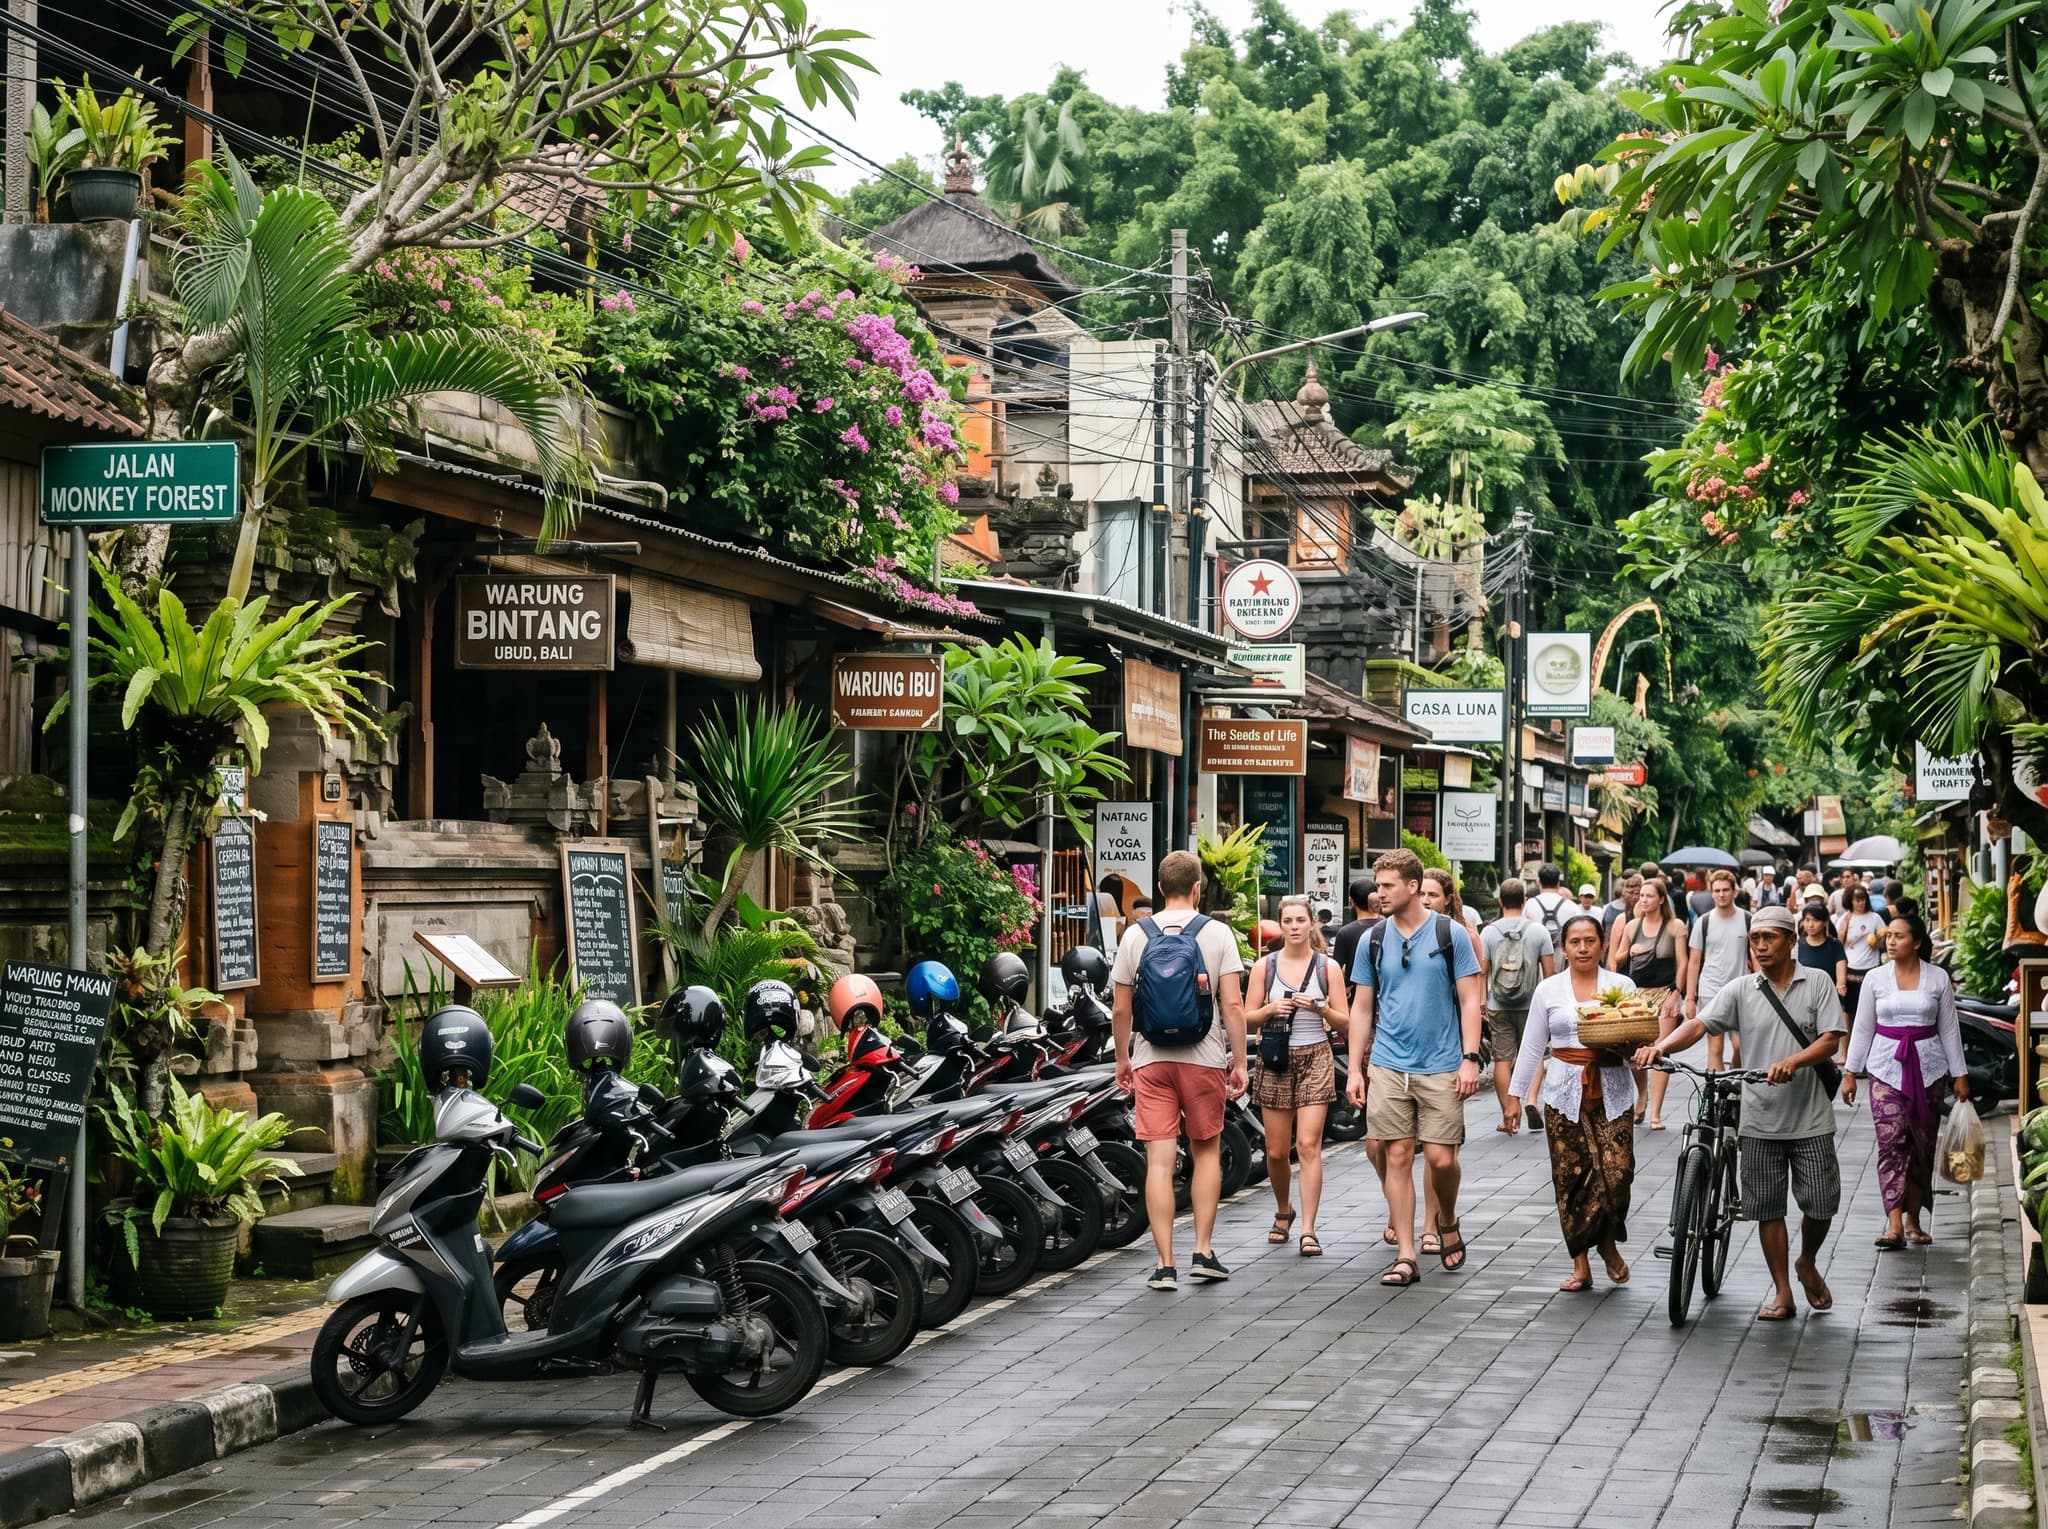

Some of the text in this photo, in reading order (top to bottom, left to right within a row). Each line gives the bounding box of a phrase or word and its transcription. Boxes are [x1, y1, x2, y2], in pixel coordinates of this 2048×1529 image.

[103, 453, 175, 479] JALAN
[51, 485, 228, 513] MONKEY FOREST
[485, 584, 584, 605] WARUNG
[467, 610, 602, 640] BINTANG
[494, 646, 573, 662] UBUD, BALI
[838, 671, 936, 697] WARUNG IBU
[1411, 703, 1497, 715] CASA LUNA
[1207, 728, 1297, 742] The Seeds of Life
[1101, 812, 1148, 822] NATANG
[1120, 825, 1128, 834] &
[1108, 838, 1141, 848] YOGA
[8, 964, 112, 997] WARUNG MAKAN
[29, 1039, 56, 1053] ARTS
[27, 1068, 72, 1084] CLASSES
